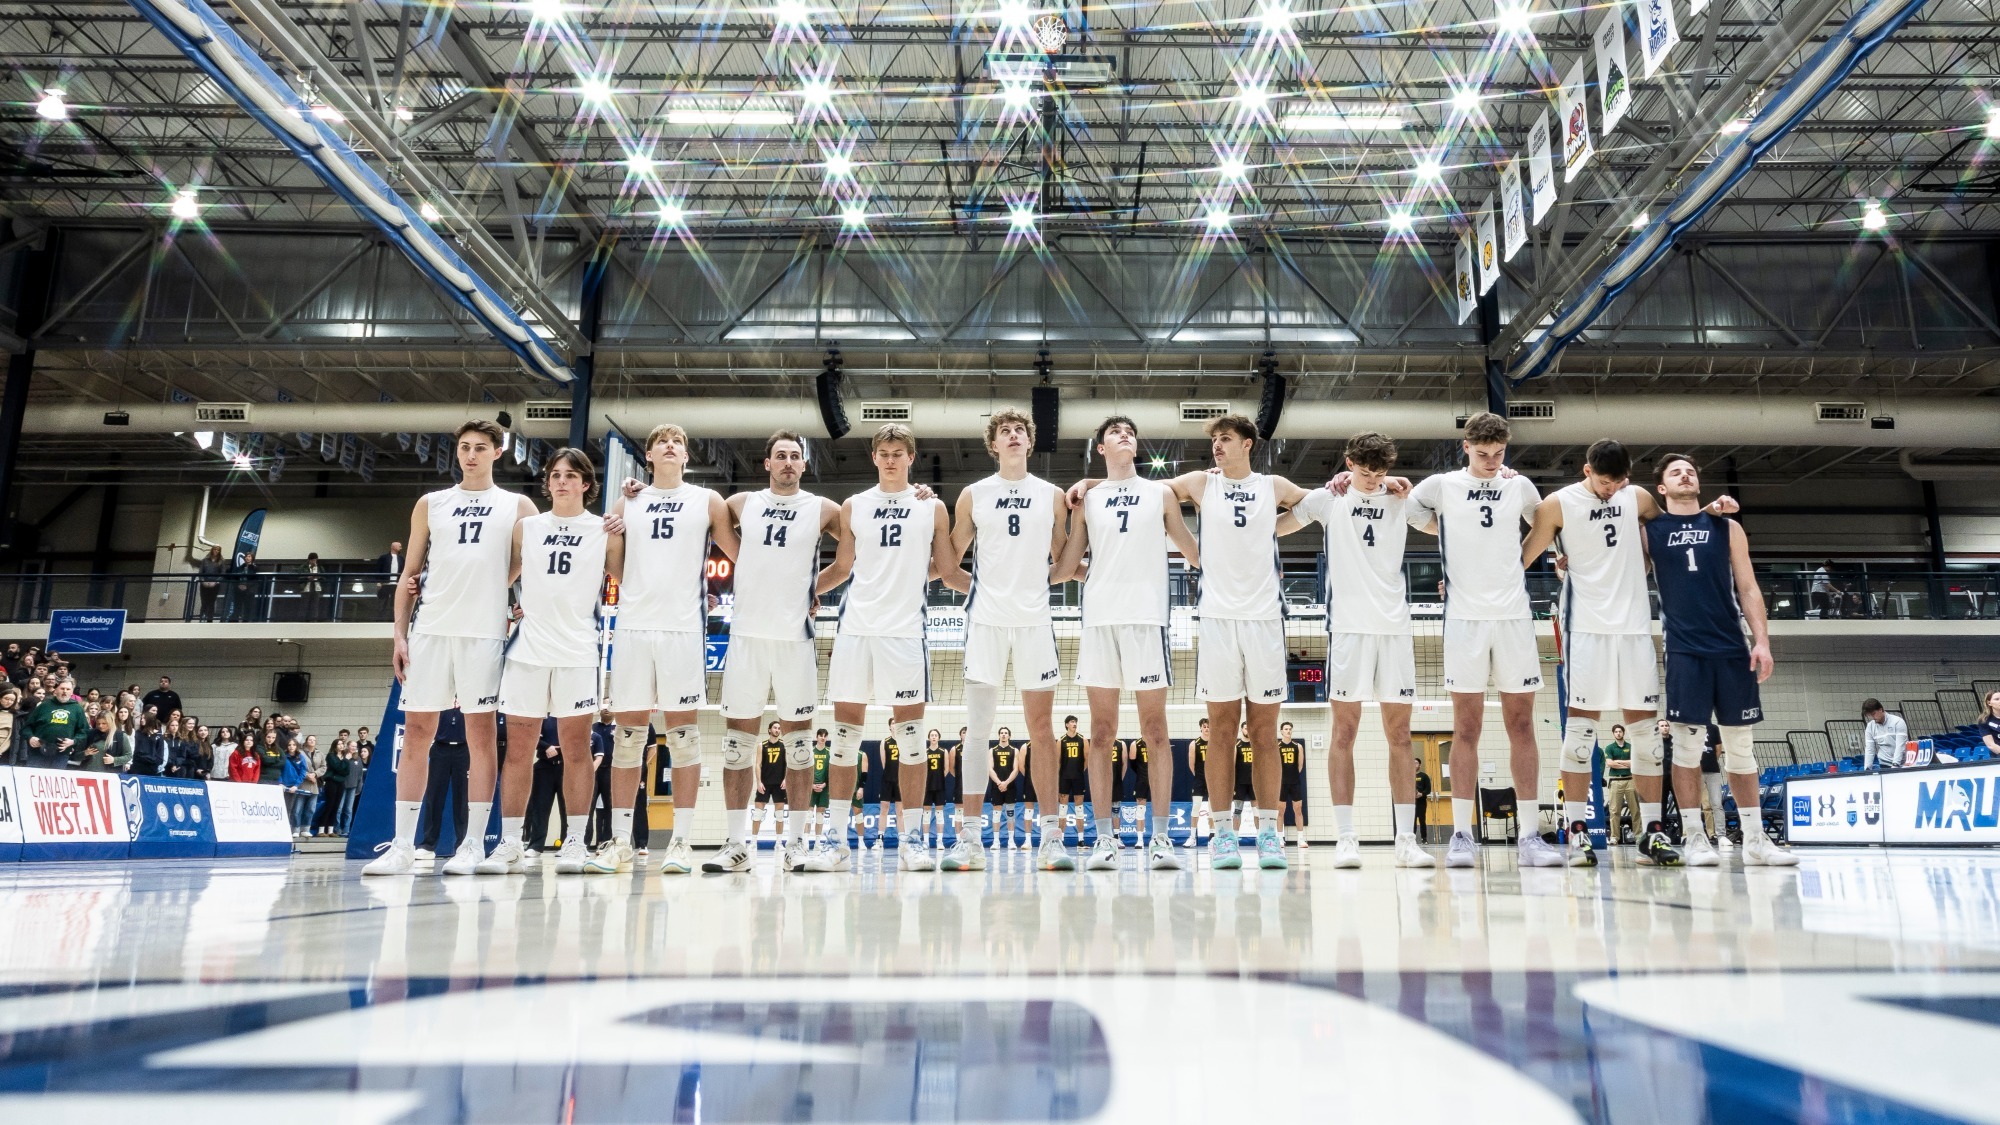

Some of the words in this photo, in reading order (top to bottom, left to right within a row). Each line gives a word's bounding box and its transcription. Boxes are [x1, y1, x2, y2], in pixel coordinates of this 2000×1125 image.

[1105, 495, 1140, 508] MRU
[1224, 491, 1256, 502] MRU
[1466, 489, 1502, 502] MRU
[645, 502, 684, 513] MRU
[995, 497, 1032, 509] MRU
[451, 506, 492, 517] MRU
[761, 507, 798, 521] MRU
[873, 507, 911, 520] MRU
[1234, 506, 1247, 528] 5
[1351, 507, 1385, 520] MRU
[1480, 505, 1494, 528] 3
[1589, 505, 1622, 521] MRU
[1008, 514, 1021, 537] 8
[1116, 510, 1129, 533] 7
[458, 521, 483, 545] 17
[651, 517, 675, 540] 15
[880, 523, 902, 547] 12
[543, 534, 583, 547] MRU
[763, 524, 787, 548] 14
[1362, 524, 1375, 547] 4
[1604, 523, 1617, 548] 2
[1667, 530, 1710, 547] MRU
[547, 551, 572, 575] 16
[1685, 548, 1698, 572] 1
[80, 616, 115, 625] Radiology
[927, 617, 964, 627] UGARS
[1139, 674, 1161, 684] MRU
[895, 689, 919, 699] MRU
[767, 752, 780, 763] 17
[1067, 746, 1078, 758] 10
[1242, 752, 1253, 763] 18
[1283, 752, 1295, 764] 19
[816, 759, 824, 770] 6
[930, 759, 938, 770] 3
[1000, 756, 1007, 767] 5
[30, 775, 79, 799] CANADA
[144, 784, 166, 794] FOLLOW
[167, 785, 178, 795] THE
[1915, 776, 2000, 831] MRU
[240, 801, 283, 820] Radiology
